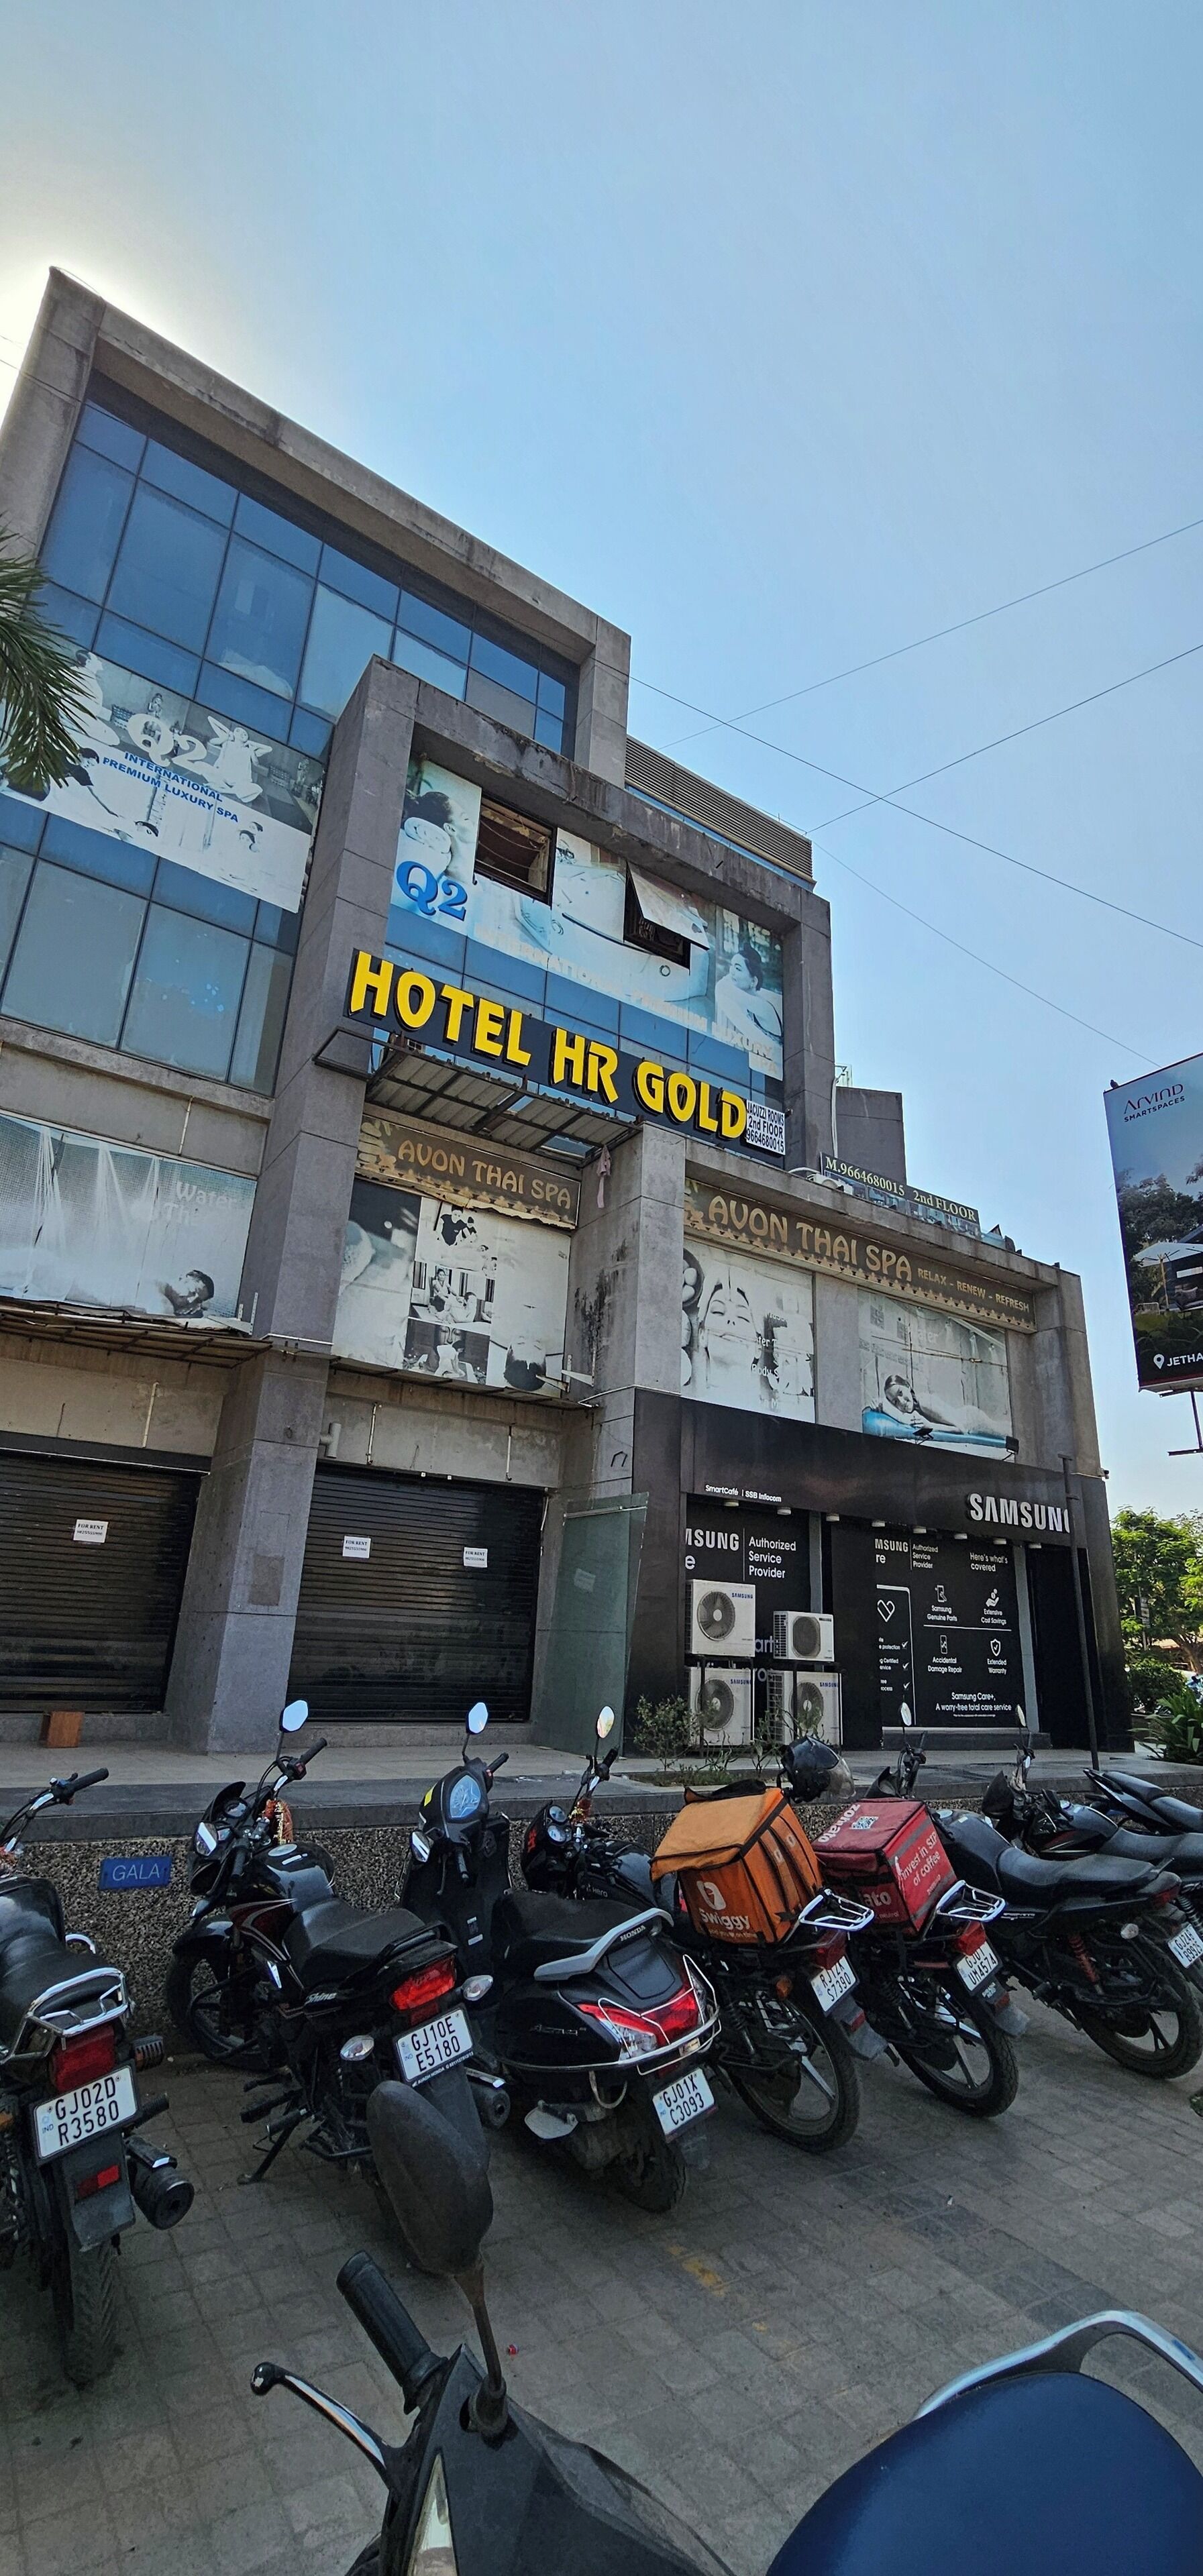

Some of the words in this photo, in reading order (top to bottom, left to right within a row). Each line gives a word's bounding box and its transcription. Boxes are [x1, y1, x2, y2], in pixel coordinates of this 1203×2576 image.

[127, 713, 215, 775] Q2
[124, 752, 223, 802] INTERNATIONAL
[164, 784, 213, 811] LUXURY
[216, 807, 239, 823] SPA
[395, 861, 468, 922] Q2
[350, 950, 531, 1066] HOTEL
[553, 1028, 619, 1104] HR
[637, 1061, 747, 1139] GOLD
[747, 1102, 767, 1120] JACUZZI
[768, 1109, 784, 1126] ROOMS
[1124, 1095, 1186, 1122] SMARTSPACES
[748, 1115, 761, 1130] 2nd
[746, 1128, 784, 1152] 9664680015
[398, 1140, 465, 1177] AVON
[472, 1160, 525, 1194] THAI
[531, 1179, 571, 1210] SPA
[825, 1156, 905, 1197] M.9664680015
[912, 1189, 934, 1207] 2nd
[936, 1197, 977, 1222] FLOOR
[709, 1196, 788, 1244] AVON
[796, 1222, 857, 1265] THAI
[866, 1245, 912, 1282] SPA
[917, 1268, 947, 1286] RELAX
[956, 1281, 986, 1299] RENEW
[995, 1293, 1031, 1313] REFRESH
[705, 1485, 739, 1495] SmartCafé
[745, 1490, 757, 1499] SSB
[758, 1493, 782, 1502] Infocom
[749, 1536, 796, 1551] Authorized
[874, 1538, 908, 1553] MSUNG
[912, 1543, 939, 1553] Authorized
[749, 1550, 782, 1564] Service
[912, 1552, 931, 1560] Service
[912, 1560, 933, 1569] Provider
[970, 1552, 989, 1562] Here's
[990, 1555, 1008, 1564] what's
[749, 1565, 786, 1578] Provider
[970, 1563, 996, 1572] covered
[931, 1605, 952, 1614] Samsung
[991, 1617, 1007, 1625] Savings
[932, 1656, 957, 1664] Accidental
[987, 1658, 1007, 1666] Extended
[927, 1665, 947, 1674] Damage
[947, 1666, 962, 1674] Repair
[988, 1667, 1007, 1675] Warranty
[951, 1691, 976, 1702] Samsung
[977, 1692, 996, 1701] Care+,
[935, 1703, 941, 1711] A
[941, 1703, 968, 1713] worry-free
[900, 1854, 921, 1879] invest
[918, 1846, 929, 1859] in
[926, 1832, 937, 1850] SIP
[112, 1863, 160, 1881] GALA
[913, 1872, 921, 1886] of
[921, 1850, 941, 1877] coffee
[592, 1886, 608, 1898] Hero
[862, 1890, 892, 1907] ato
[699, 1908, 750, 1930] Swiggy
[619, 1925, 646, 1941] HONDA
[968, 1953, 997, 1985] UM4574
[827, 1972, 851, 2002] S7390
[411, 2016, 456, 2051] GJ10E
[416, 2035, 461, 2072] E5180
[55, 2076, 116, 2121] GJ02D
[663, 2074, 698, 2108] GJ01X
[670, 2092, 704, 2126] C3093
[42, 2123, 54, 2134] IND
[58, 2100, 119, 2147] R3580
